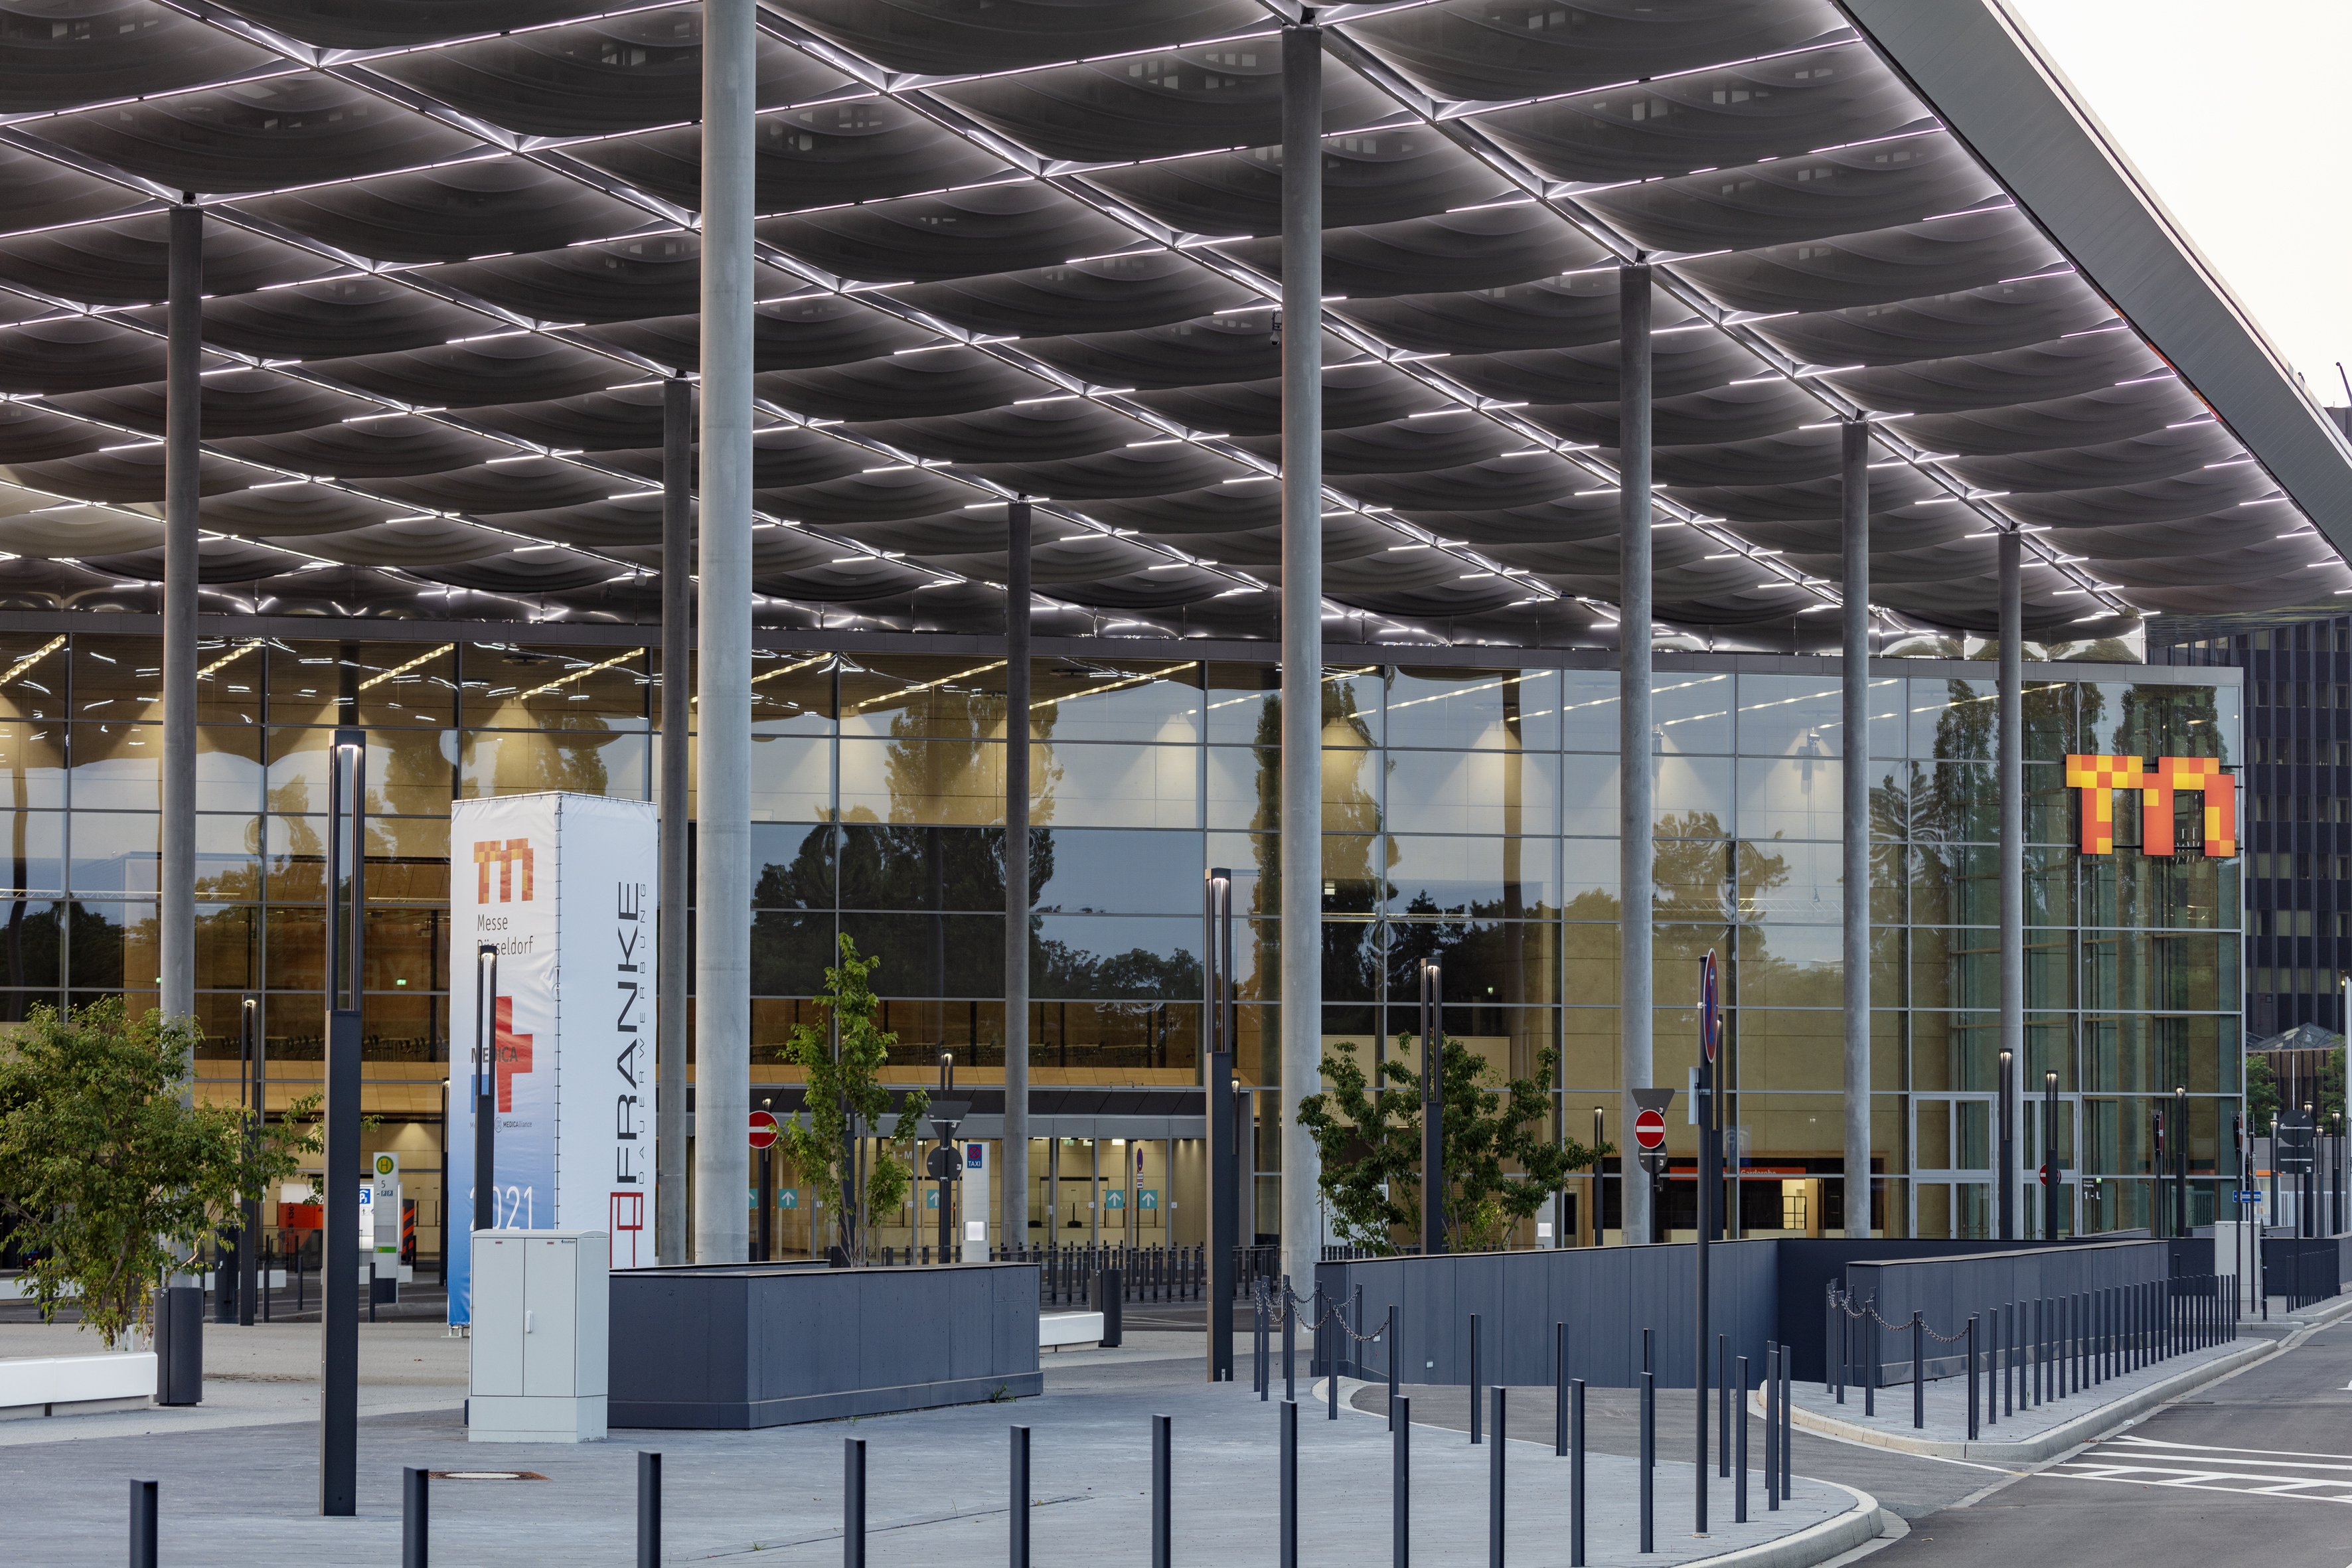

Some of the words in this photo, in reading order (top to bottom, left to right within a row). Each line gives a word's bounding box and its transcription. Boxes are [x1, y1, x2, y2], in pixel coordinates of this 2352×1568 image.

[477, 913, 508, 931] Messe
[617, 882, 638, 1184] FRANKE
[2084, 1191, 2088, 1199] 1
[2096, 1191, 2101, 1199] L
